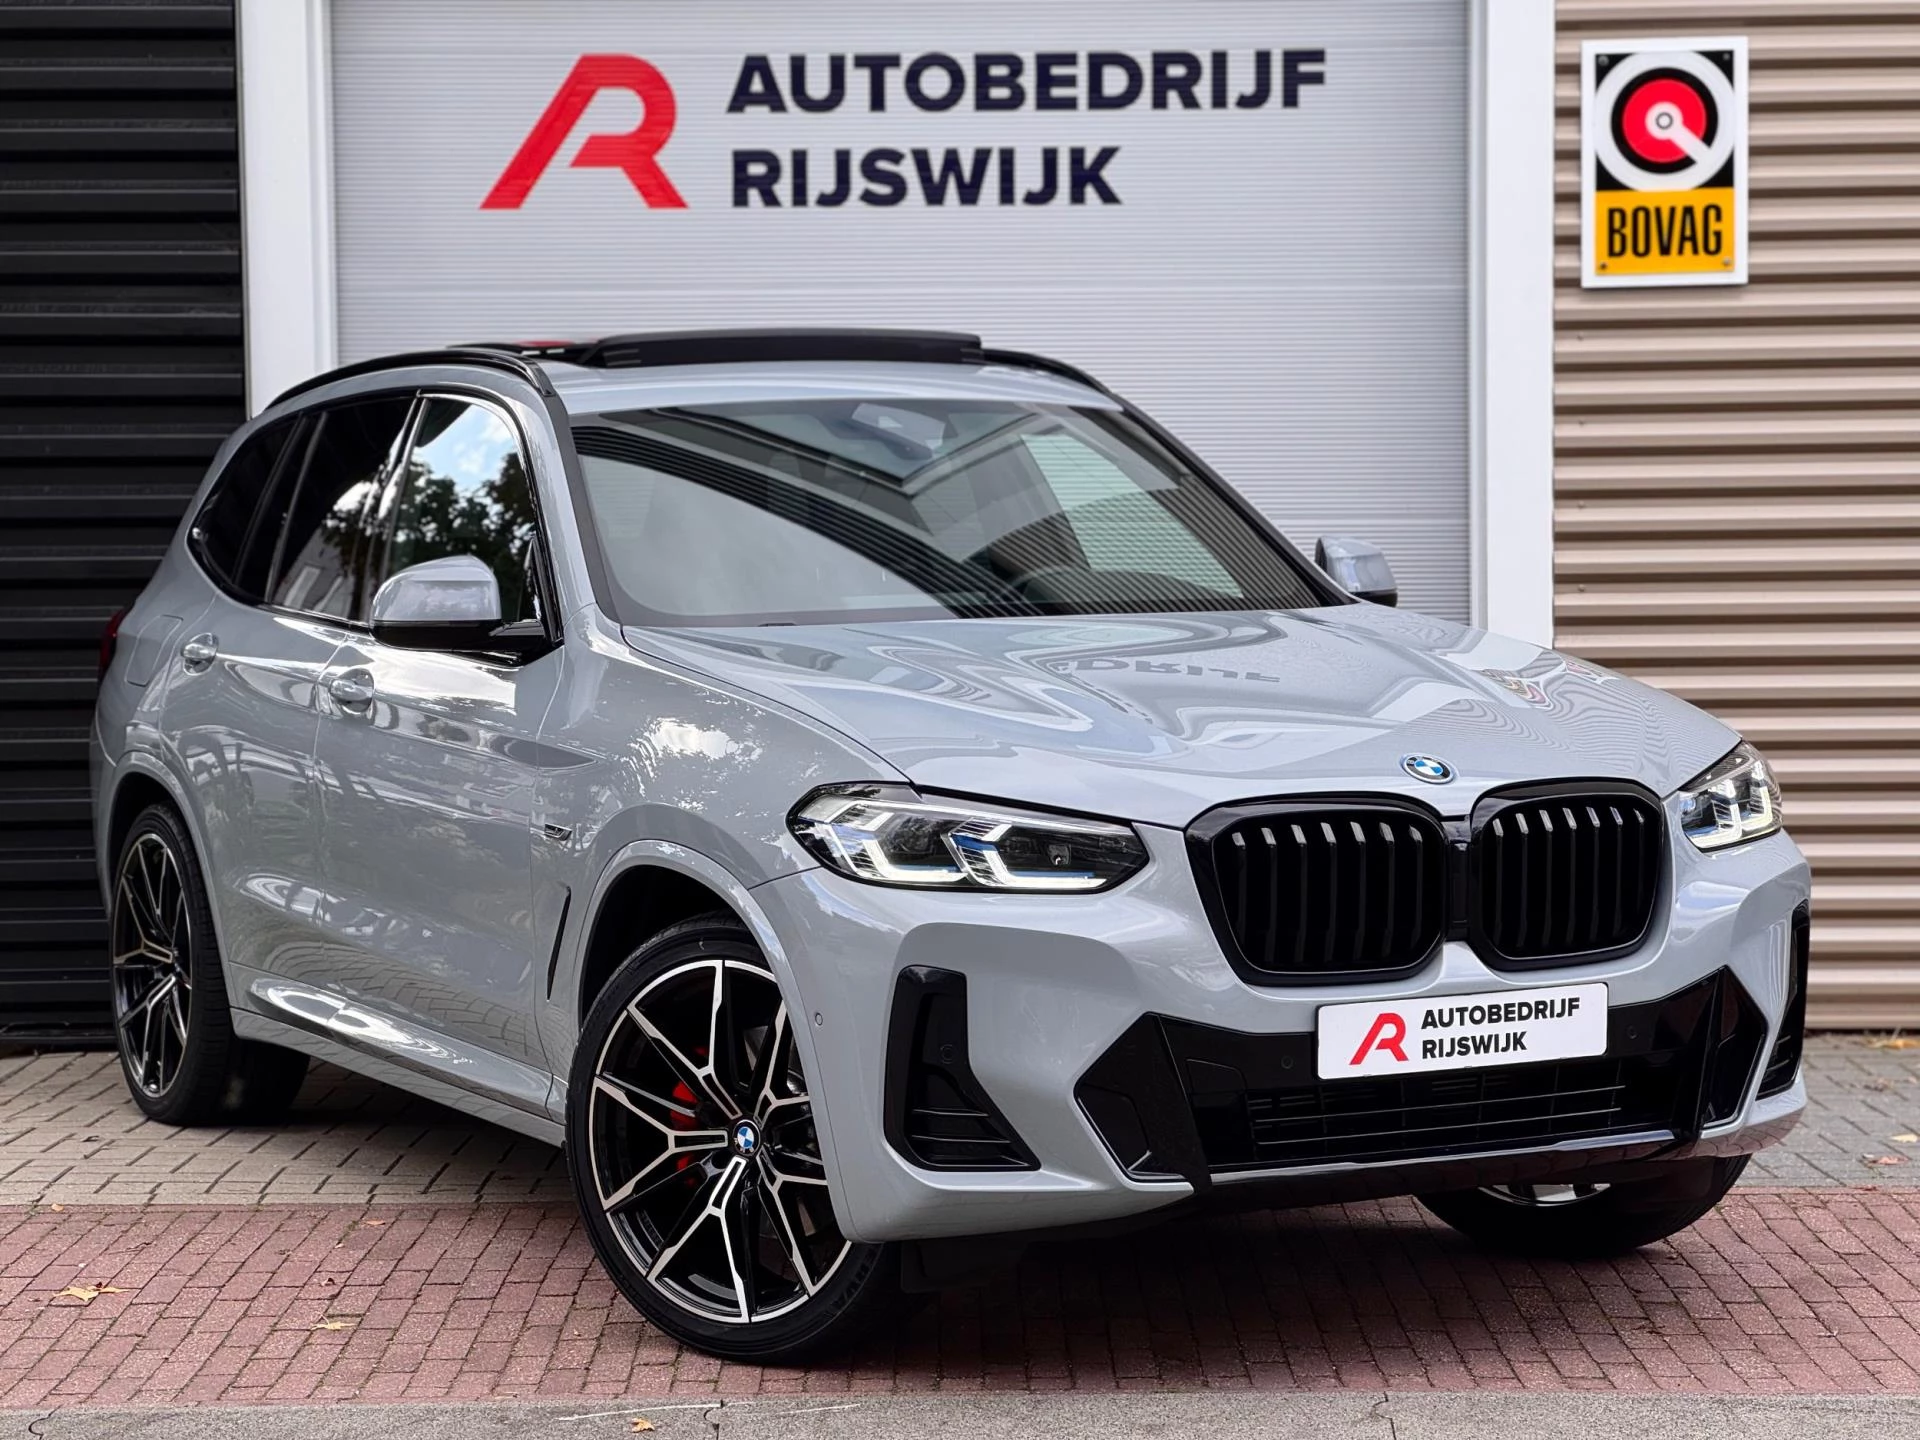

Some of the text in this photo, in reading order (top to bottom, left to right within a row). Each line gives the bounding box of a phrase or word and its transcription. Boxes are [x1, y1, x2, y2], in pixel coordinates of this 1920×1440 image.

[727, 49, 1326, 113] AUTOBEDRIJF
[732, 146, 1122, 208] RIJSWIJK
[1607, 203, 1722, 258] BOVAG
[1420, 997, 1580, 1030] AUTOBEDRIJF
[1421, 1031, 1527, 1060] RIJSWIJK
